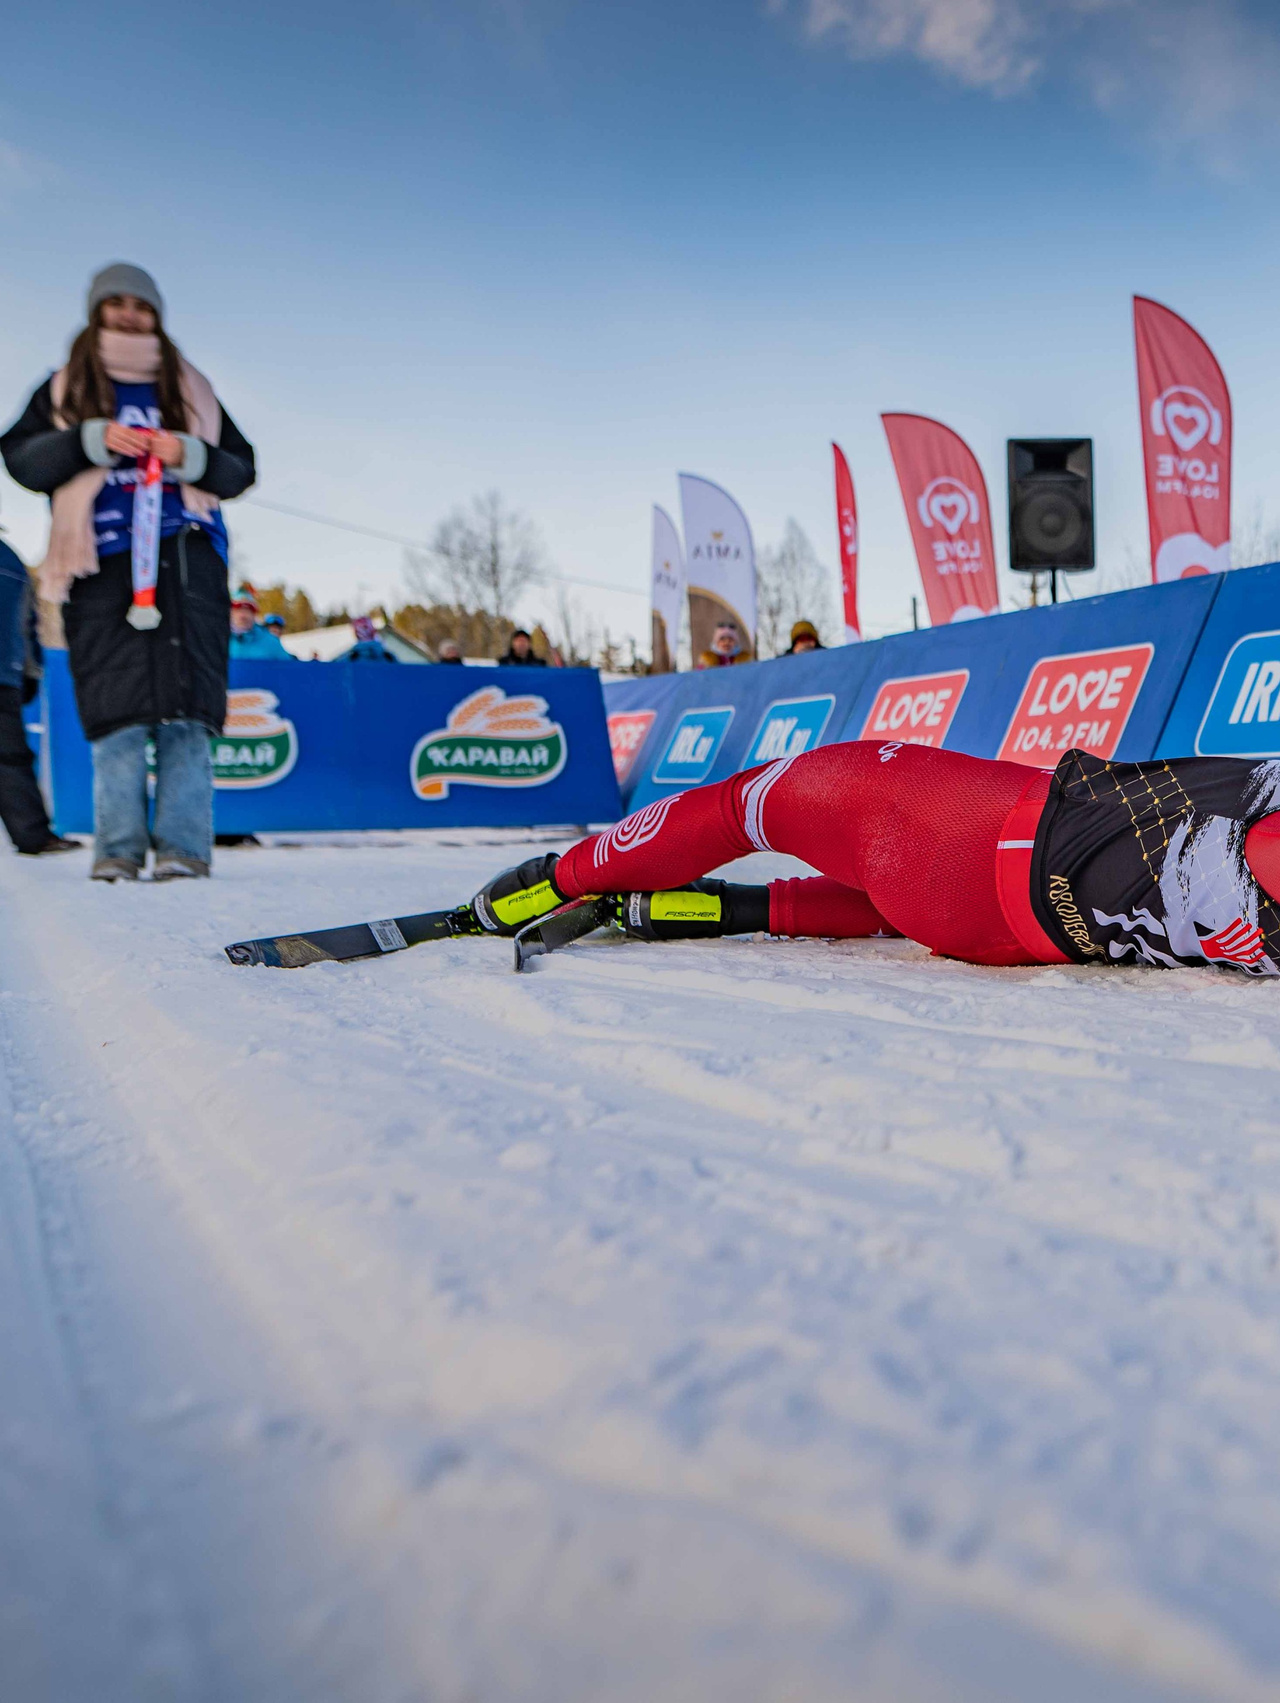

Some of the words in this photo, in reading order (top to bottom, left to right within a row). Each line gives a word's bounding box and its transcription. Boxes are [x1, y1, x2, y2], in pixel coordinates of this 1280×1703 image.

[1028, 666, 1132, 717] LOVE
[873, 688, 953, 732] LOVE
[426, 744, 550, 767] КАРАВАЙ
[507, 884, 552, 906] FISCHER
